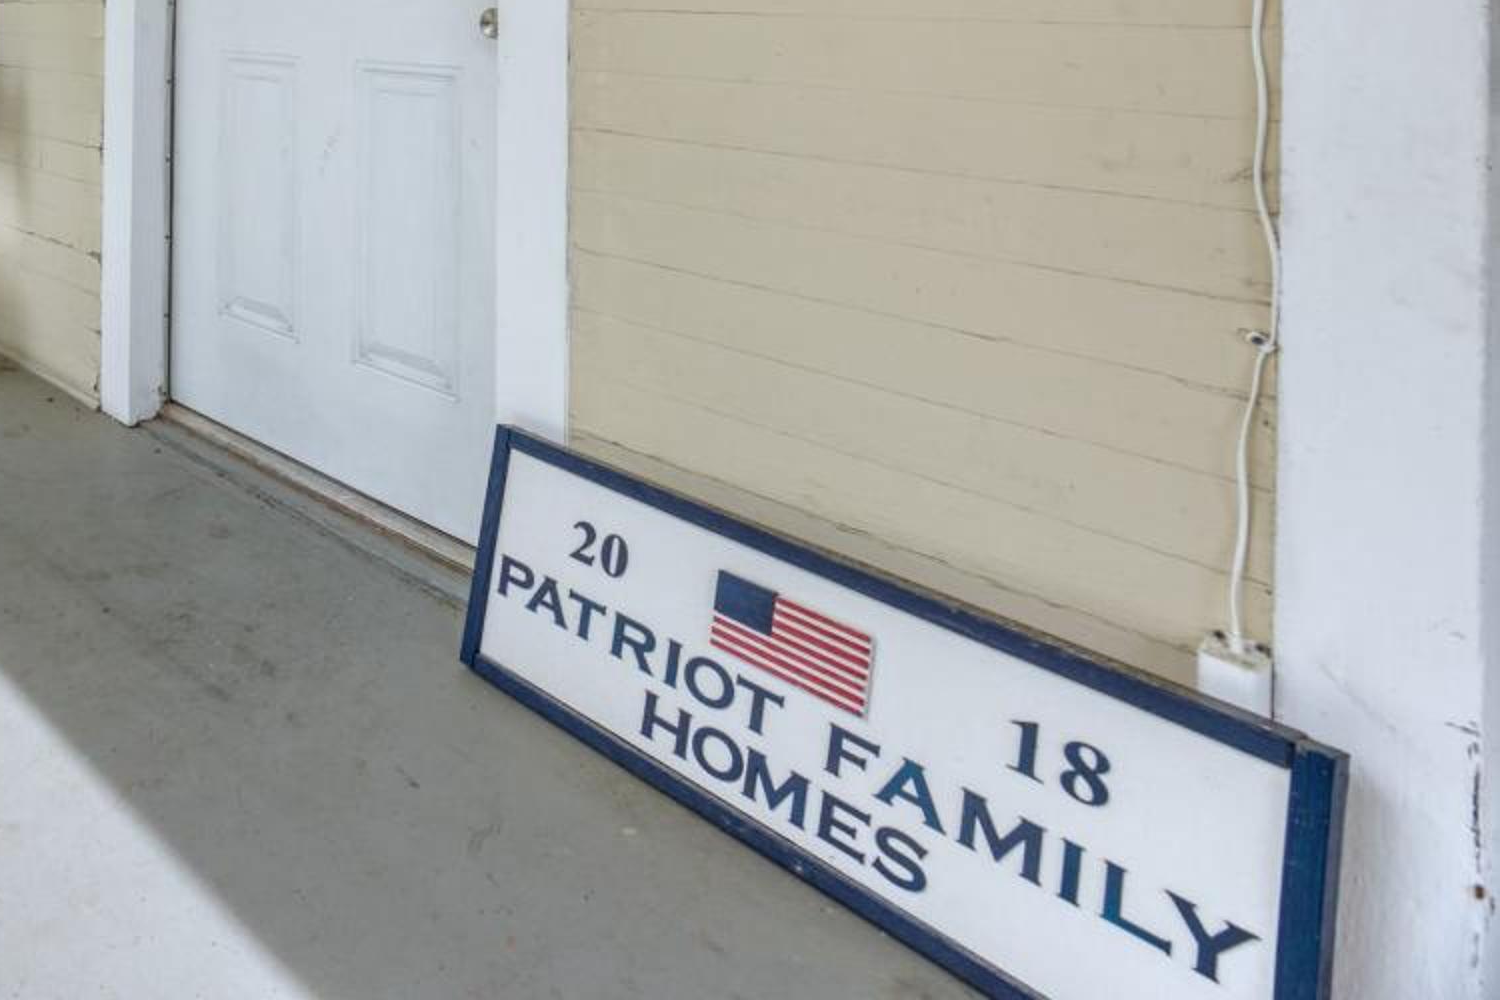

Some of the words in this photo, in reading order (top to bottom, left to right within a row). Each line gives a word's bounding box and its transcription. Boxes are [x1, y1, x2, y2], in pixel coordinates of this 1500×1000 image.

[569, 520, 629, 579] 20
[497, 553, 785, 736] PATRIOT
[823, 722, 1263, 984] FAMILY
[640, 688, 928, 893] HOMES
[1005, 719, 1112, 807] 18
